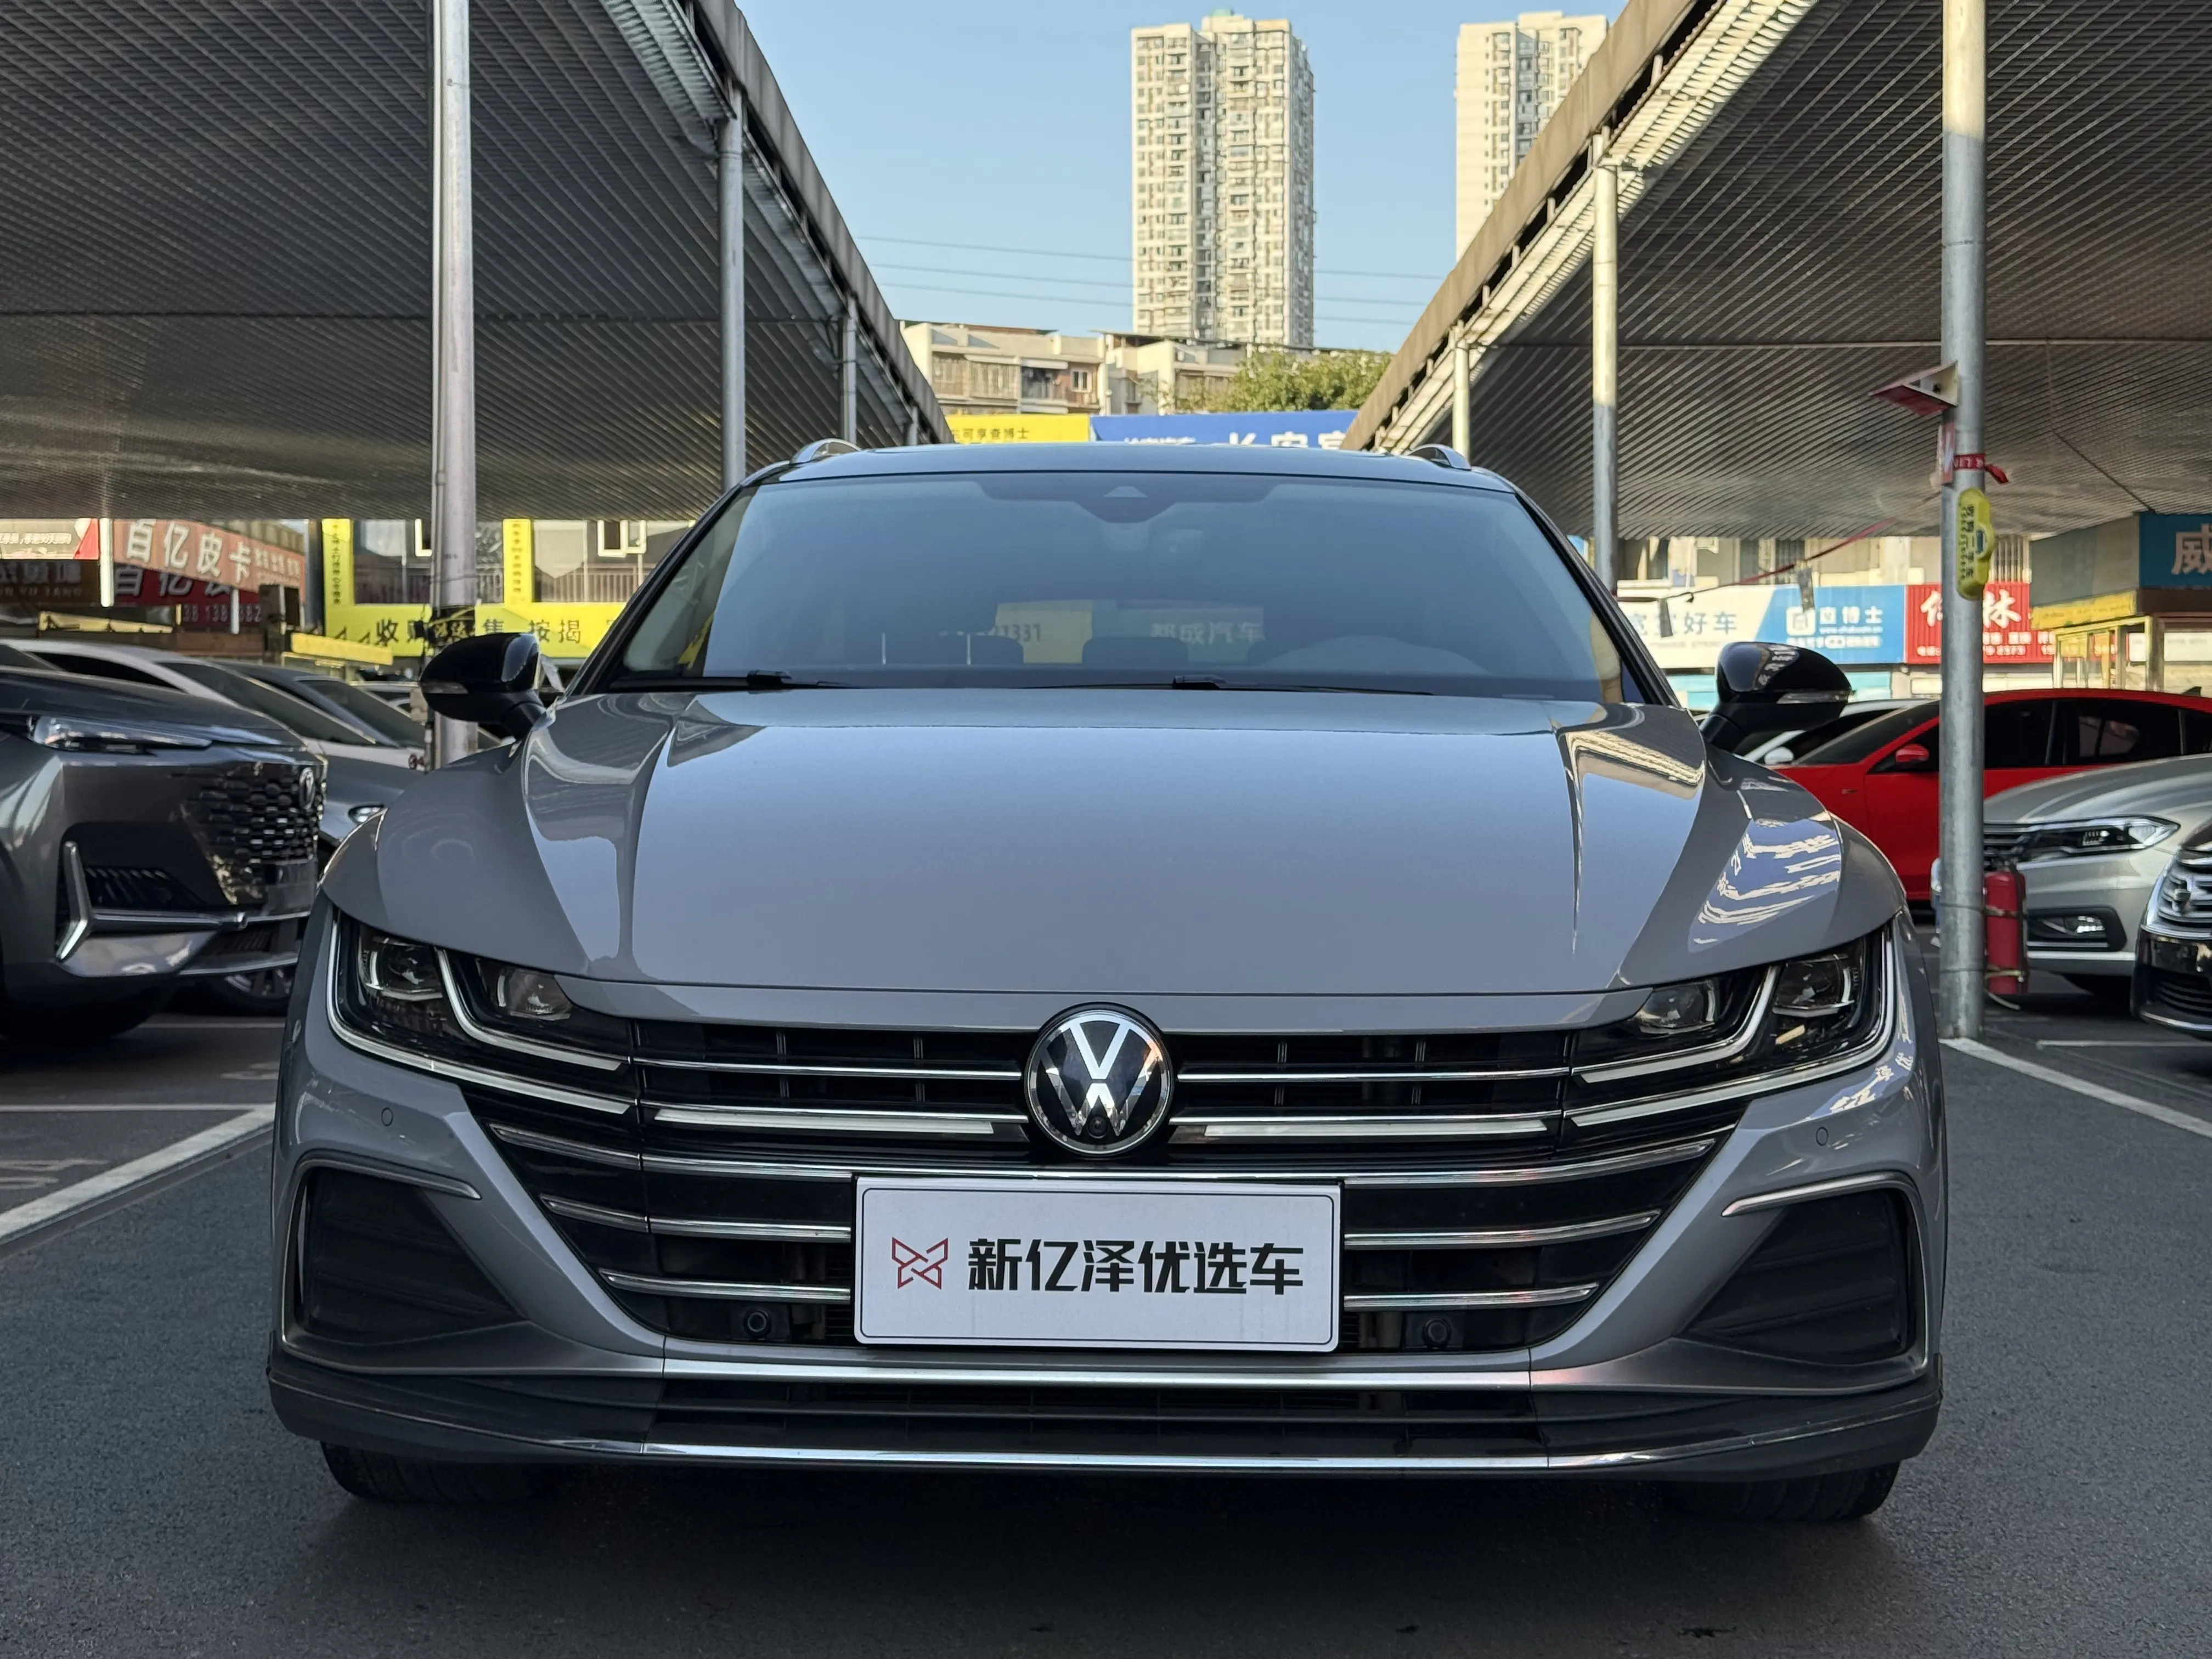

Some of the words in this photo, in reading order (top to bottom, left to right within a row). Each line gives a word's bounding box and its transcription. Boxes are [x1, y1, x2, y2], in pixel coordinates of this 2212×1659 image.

[968, 1238, 1304, 1295] 新亿泽优选车
